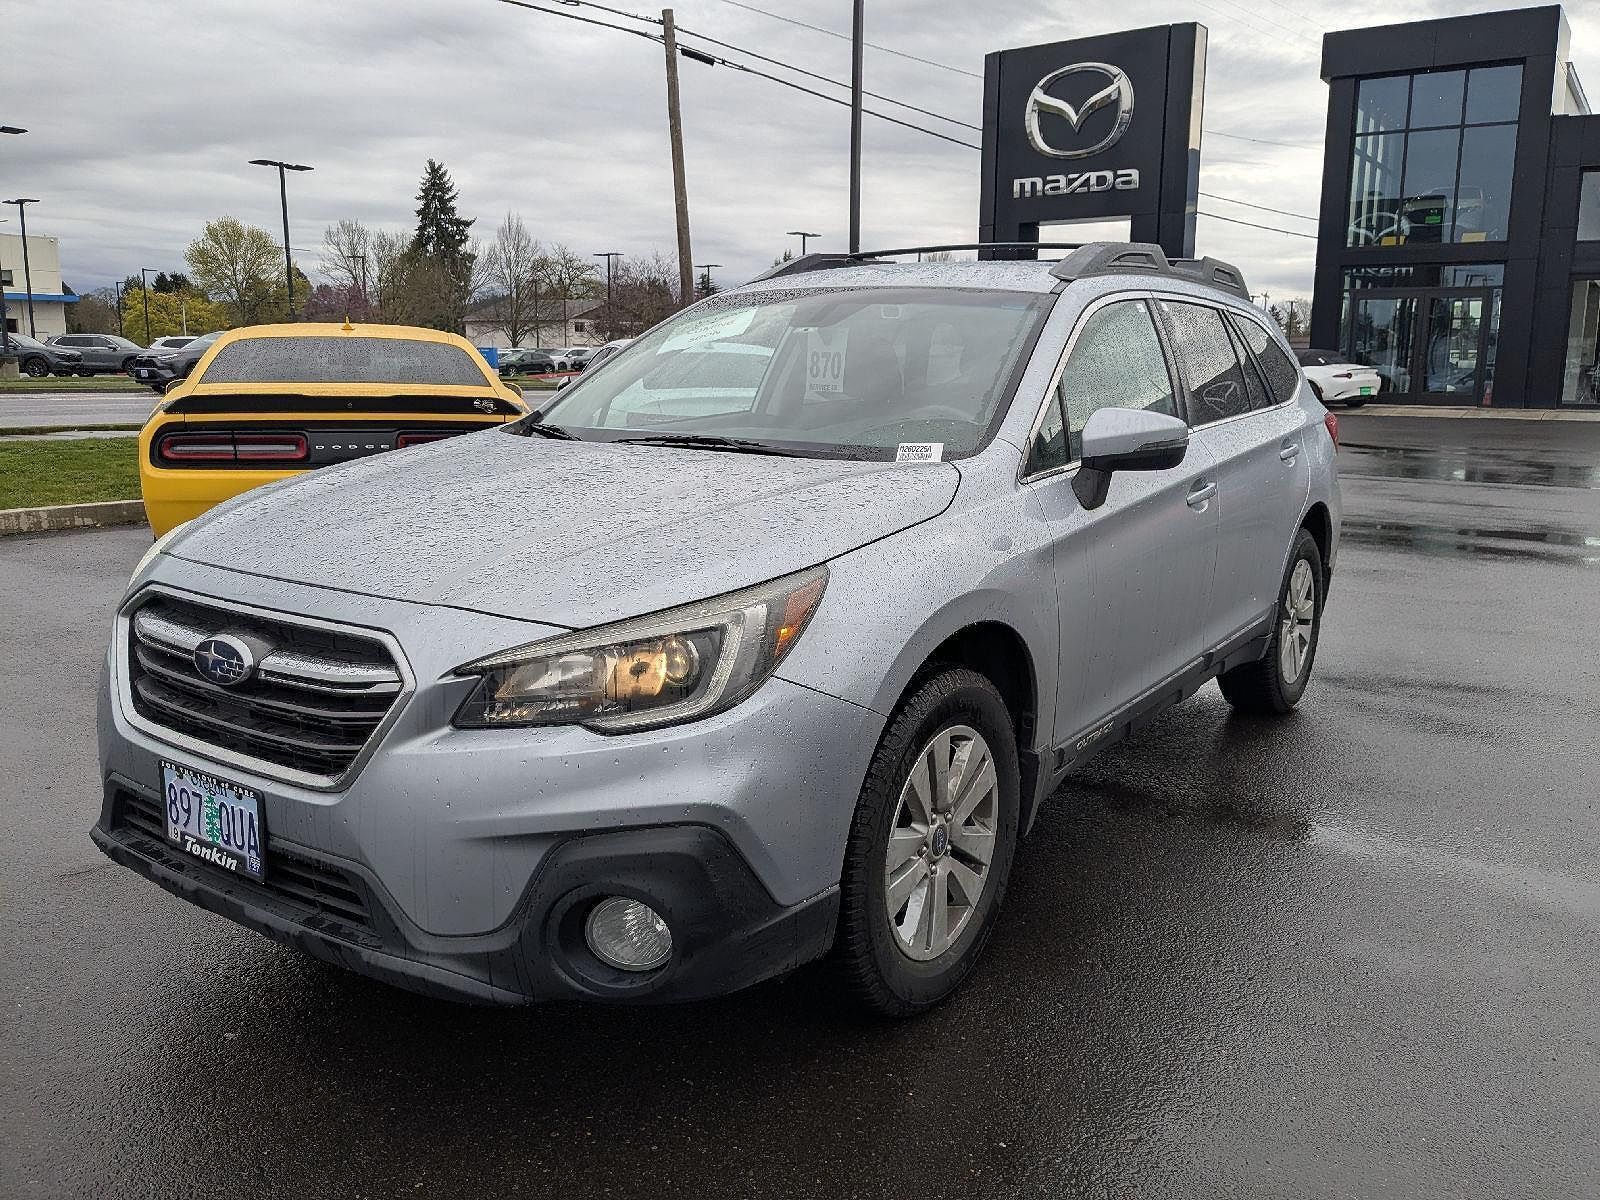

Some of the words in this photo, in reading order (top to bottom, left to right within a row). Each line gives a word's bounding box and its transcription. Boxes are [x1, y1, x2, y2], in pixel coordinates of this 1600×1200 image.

[810, 351, 842, 379] 870
[161, 760, 176, 770] FOR
[167, 782, 203, 835] 897
[218, 801, 260, 858] QUA
[184, 835, 238, 871] Tonkin
